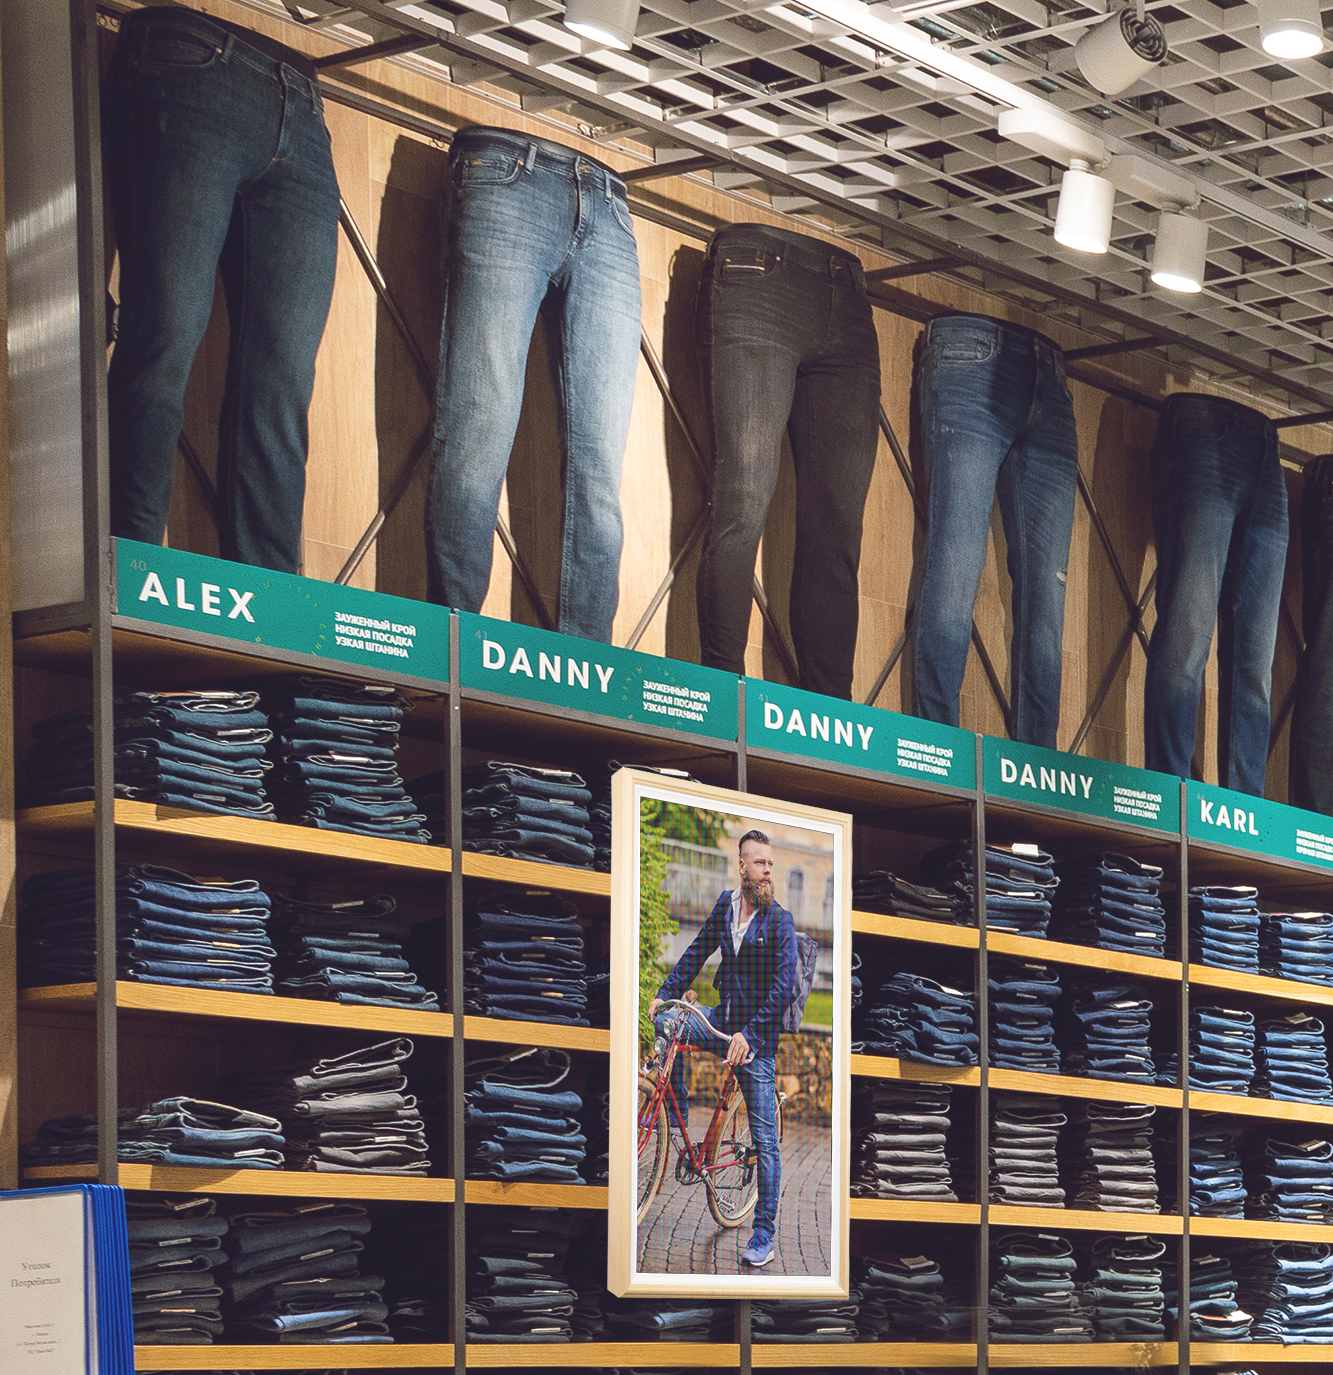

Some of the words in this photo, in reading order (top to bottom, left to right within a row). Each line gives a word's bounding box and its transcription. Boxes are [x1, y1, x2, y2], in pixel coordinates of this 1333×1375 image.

[138, 571, 255, 623] ALEX
[335, 611, 390, 631] ЗАУЖЕННЫЙ
[391, 623, 416, 636] КРОЙ
[335, 624, 371, 639] НИЗКАЯ
[372, 630, 414, 648] ПОСАДКА
[335, 636, 364, 650] УЗКАЯ
[482, 639, 615, 693] DANNY
[643, 679, 689, 698] ЗАУЖЕННЫЙ
[690, 690, 711, 702] КРОЙ
[643, 691, 673, 705] НИЗКАЯ
[673, 697, 709, 713] ПОСАДКА
[643, 701, 667, 715] УЗКАЯ
[763, 701, 874, 751] DANNY
[1000, 757, 1094, 799] DANNY
[1201, 799, 1259, 836] KARL
